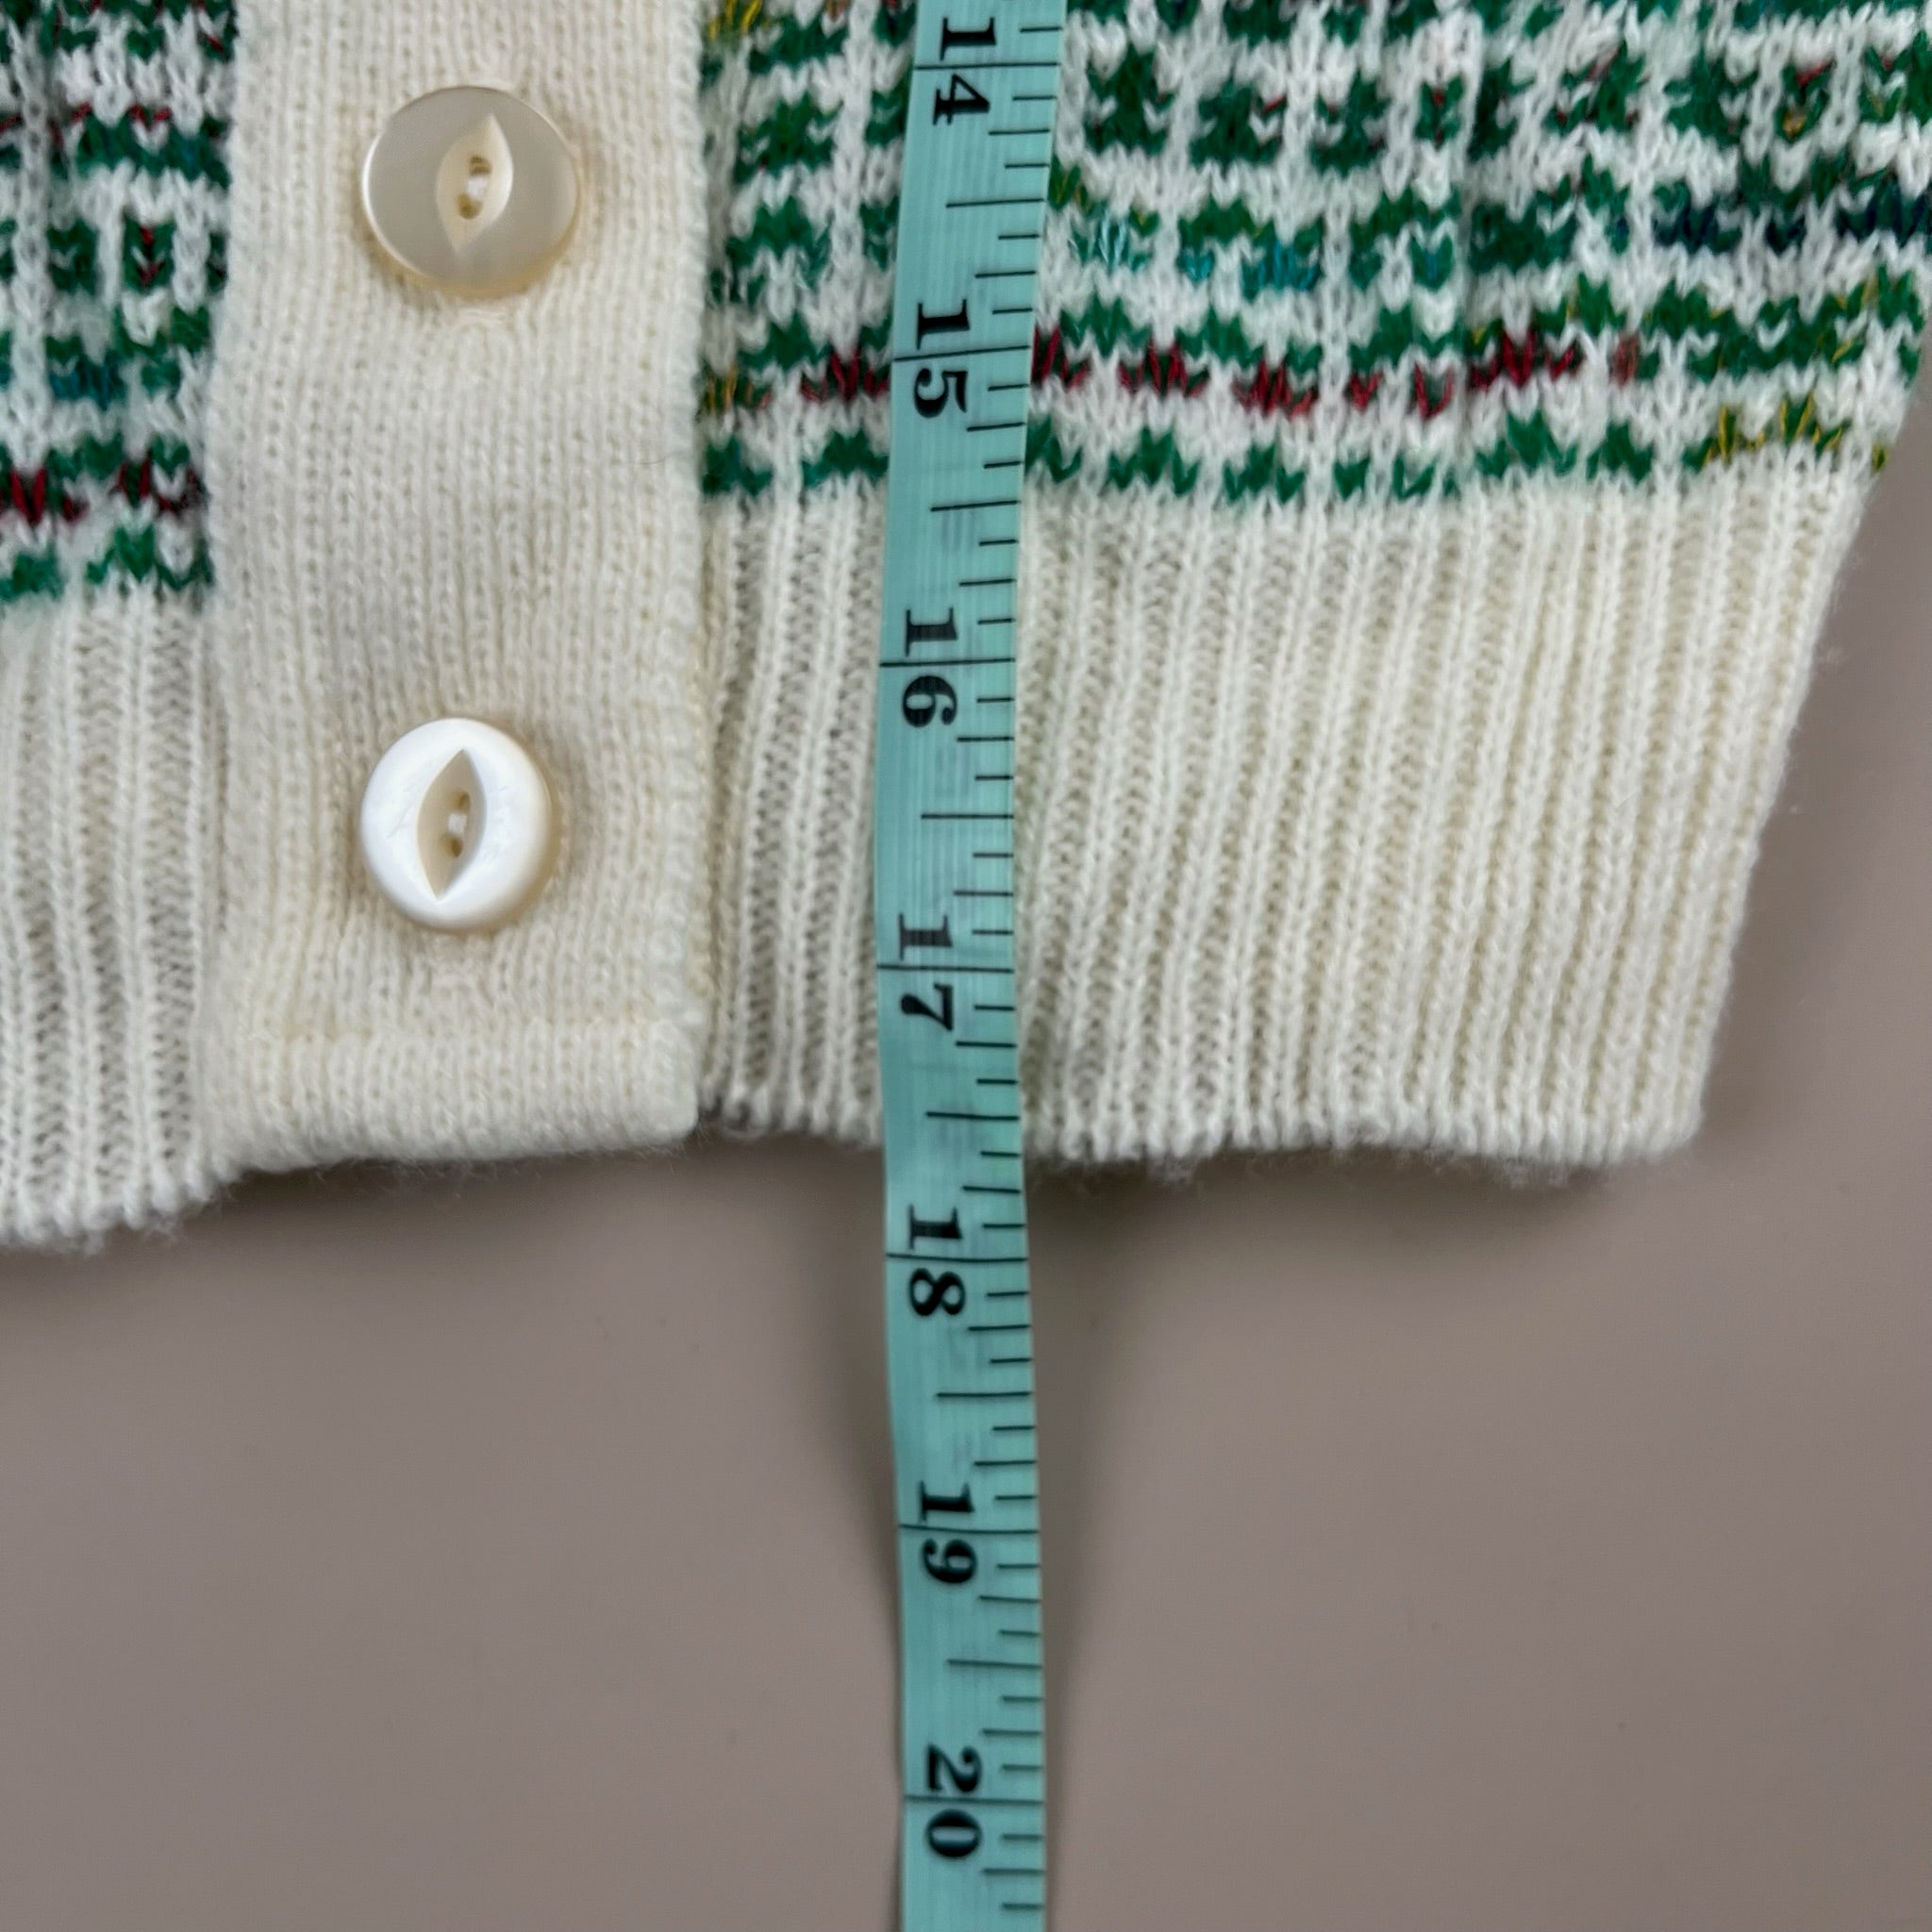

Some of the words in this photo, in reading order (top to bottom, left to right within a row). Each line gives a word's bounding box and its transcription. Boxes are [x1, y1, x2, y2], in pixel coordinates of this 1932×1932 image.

[932, 16, 997, 126] 14
[912, 297, 971, 420] 15
[902, 607, 959, 729] 16
[898, 912, 956, 1033] 17
[908, 1204, 967, 1320] 18
[918, 1480, 978, 1590] 19
[924, 1744, 984, 1863] 20
